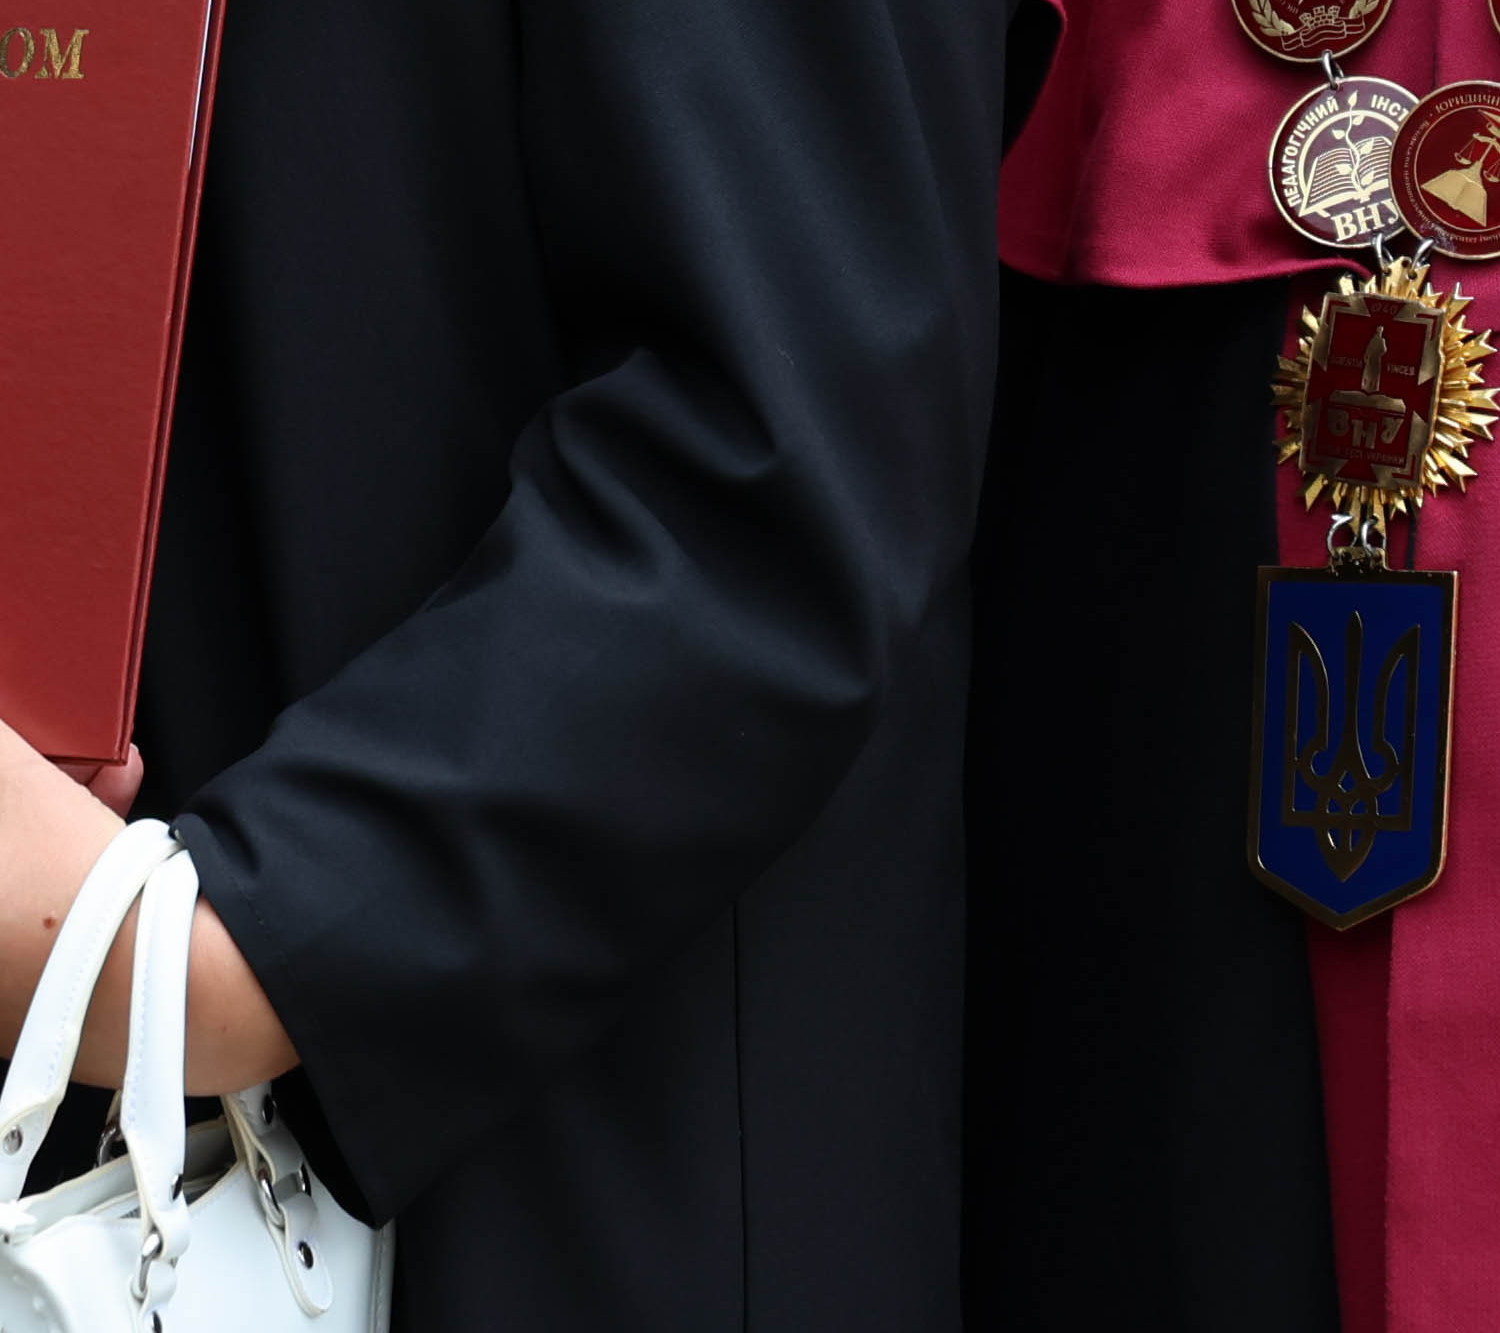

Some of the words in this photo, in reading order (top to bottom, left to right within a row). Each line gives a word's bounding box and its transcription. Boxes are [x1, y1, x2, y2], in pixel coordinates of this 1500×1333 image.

[1281, 96, 1339, 208] ПЕДАГОГІЧНИЙ
[1370, 94, 1409, 122] ІНСТ
[1330, 198, 1400, 243] ВНУ
